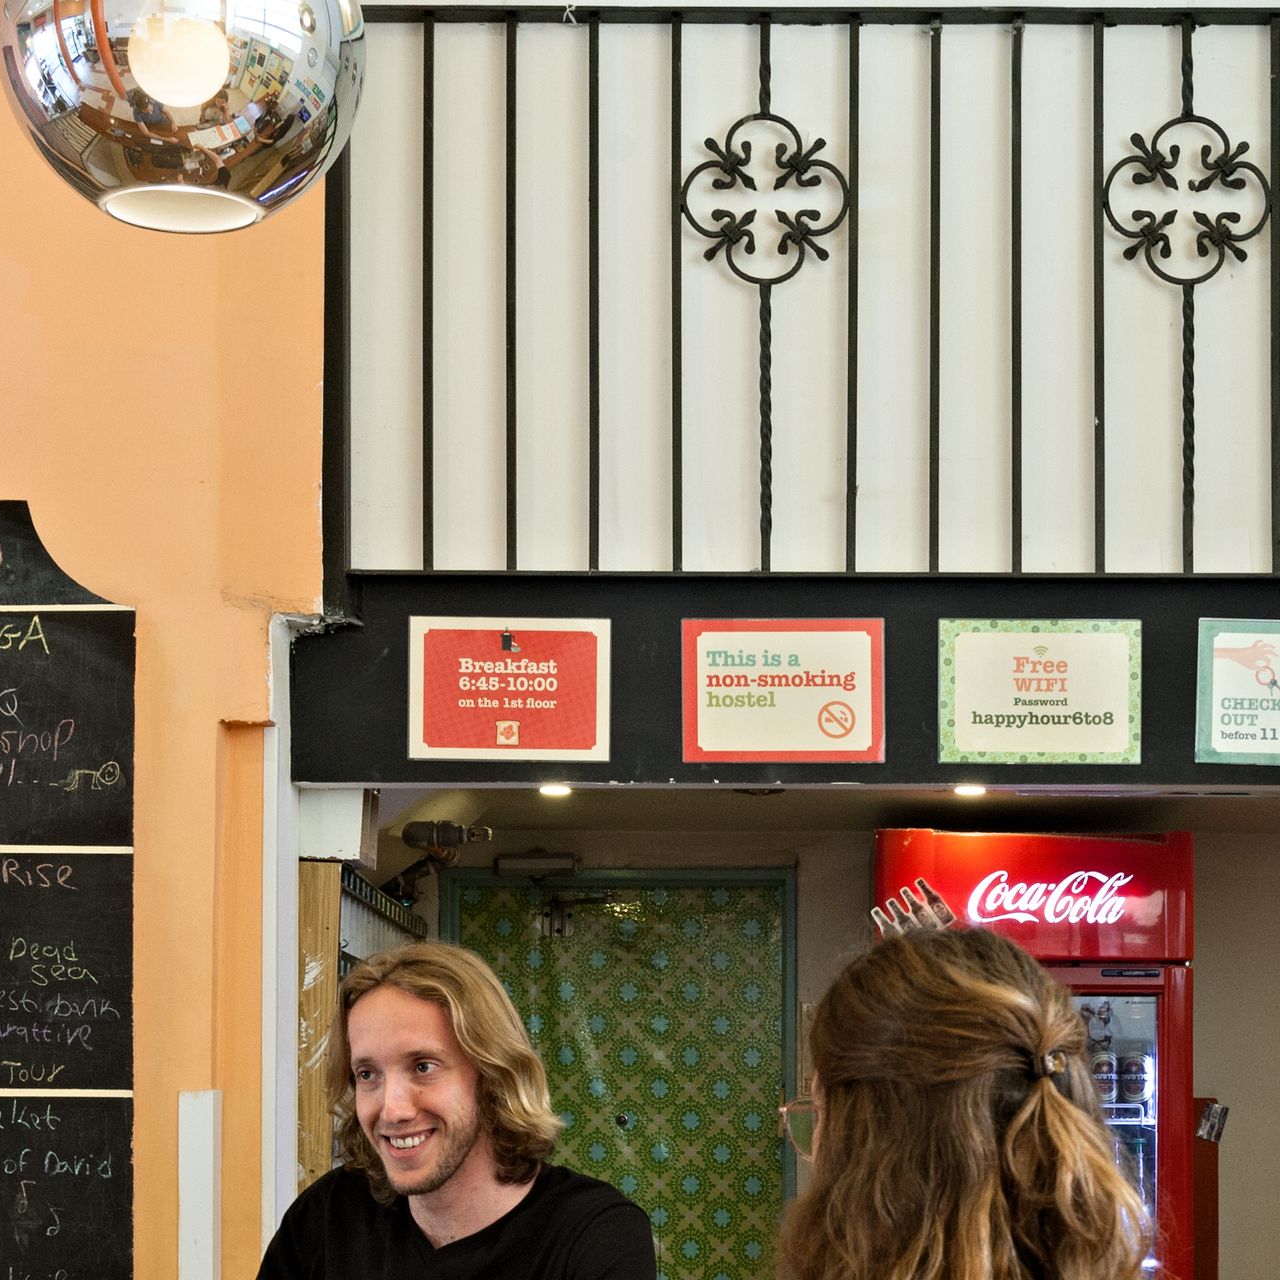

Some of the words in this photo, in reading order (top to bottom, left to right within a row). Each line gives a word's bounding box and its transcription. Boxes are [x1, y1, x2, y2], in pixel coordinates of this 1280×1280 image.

[458, 658, 558, 674] Breakfast
[706, 650, 756, 667] This
[762, 650, 782, 667] is
[788, 654, 800, 667] a
[1013, 656, 1068, 674] Free
[458, 676, 558, 692] 6:45-10:00
[706, 669, 856, 691] non-smoking
[1013, 677, 1068, 692] WIFI
[458, 699, 475, 708] on
[477, 697, 499, 708] the
[503, 698, 523, 709] 1st
[526, 698, 557, 709] floor
[706, 691, 776, 708] hostel
[1013, 697, 1068, 707] Password
[971, 711, 1114, 728] happyhour6to8
[1220, 713, 1258, 727] OUT
[1220, 730, 1257, 741] before
[4, 1149, 31, 1176] of
